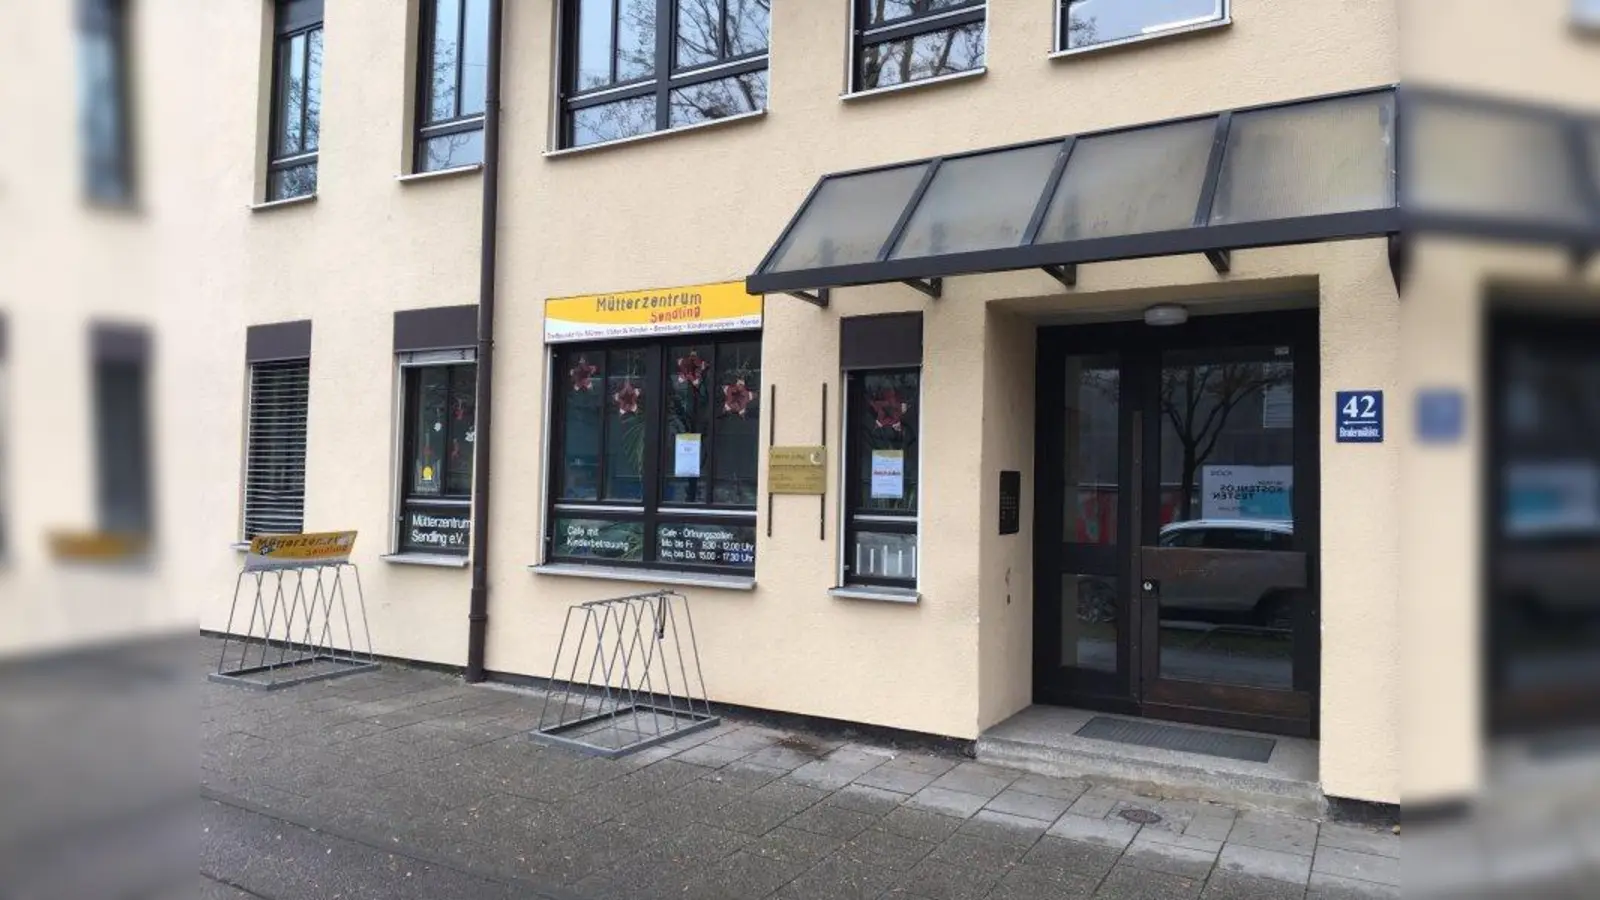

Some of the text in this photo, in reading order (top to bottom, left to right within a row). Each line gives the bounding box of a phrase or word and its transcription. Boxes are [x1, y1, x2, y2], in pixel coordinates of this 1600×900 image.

[596, 292, 702, 312] Mütterzentrum
[650, 305, 701, 323] Sendling
[1342, 395, 1377, 418] 42
[412, 513, 471, 529] Mütterzentrum
[412, 529, 447, 546] Sendling
[587, 528, 599, 537] mit
[567, 536, 629, 552] Kinderbetreuung
[674, 539, 684, 548] bis
[741, 543, 754, 552] Uhr
[674, 551, 685, 559] bis
[741, 554, 754, 563] Uhr
